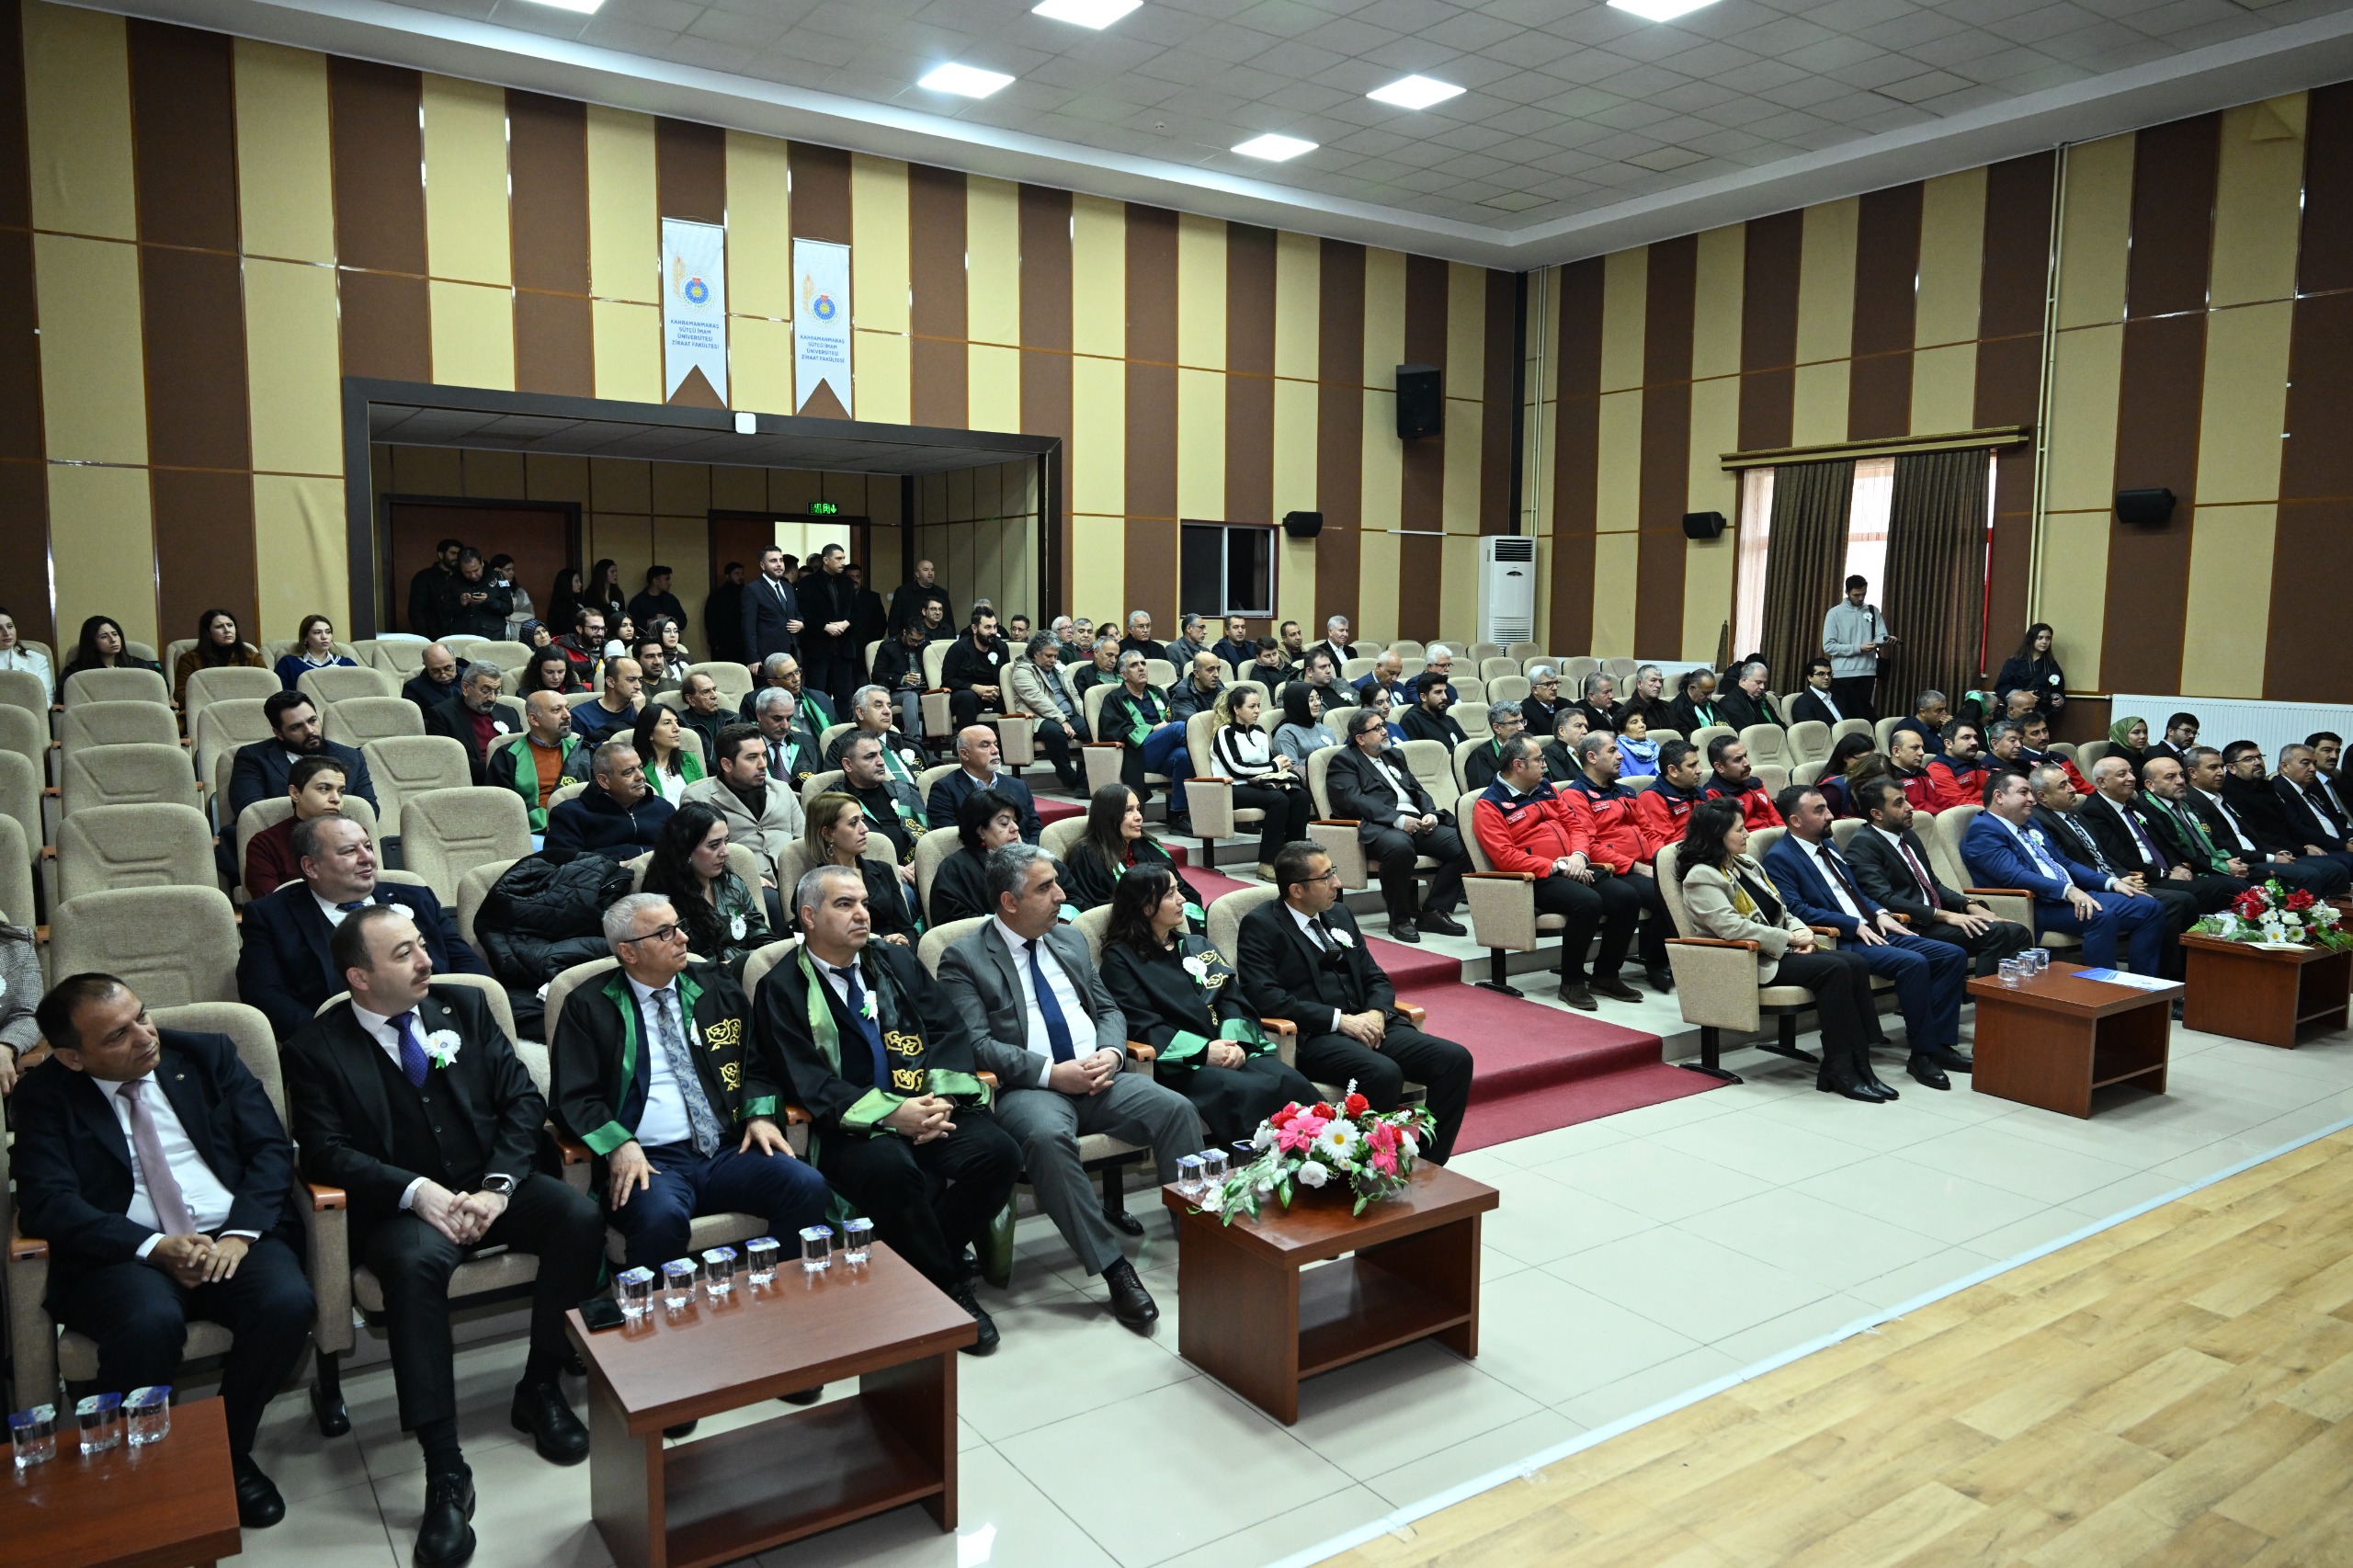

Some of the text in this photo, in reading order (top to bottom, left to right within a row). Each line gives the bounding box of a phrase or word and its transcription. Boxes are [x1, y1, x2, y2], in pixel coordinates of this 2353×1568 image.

[670, 319, 720, 329] KAHRAMANMARAŞ
[677, 333, 713, 342] ÜNİVERSİTESİ
[801, 335, 845, 344] KAHRAMANMARAŞ
